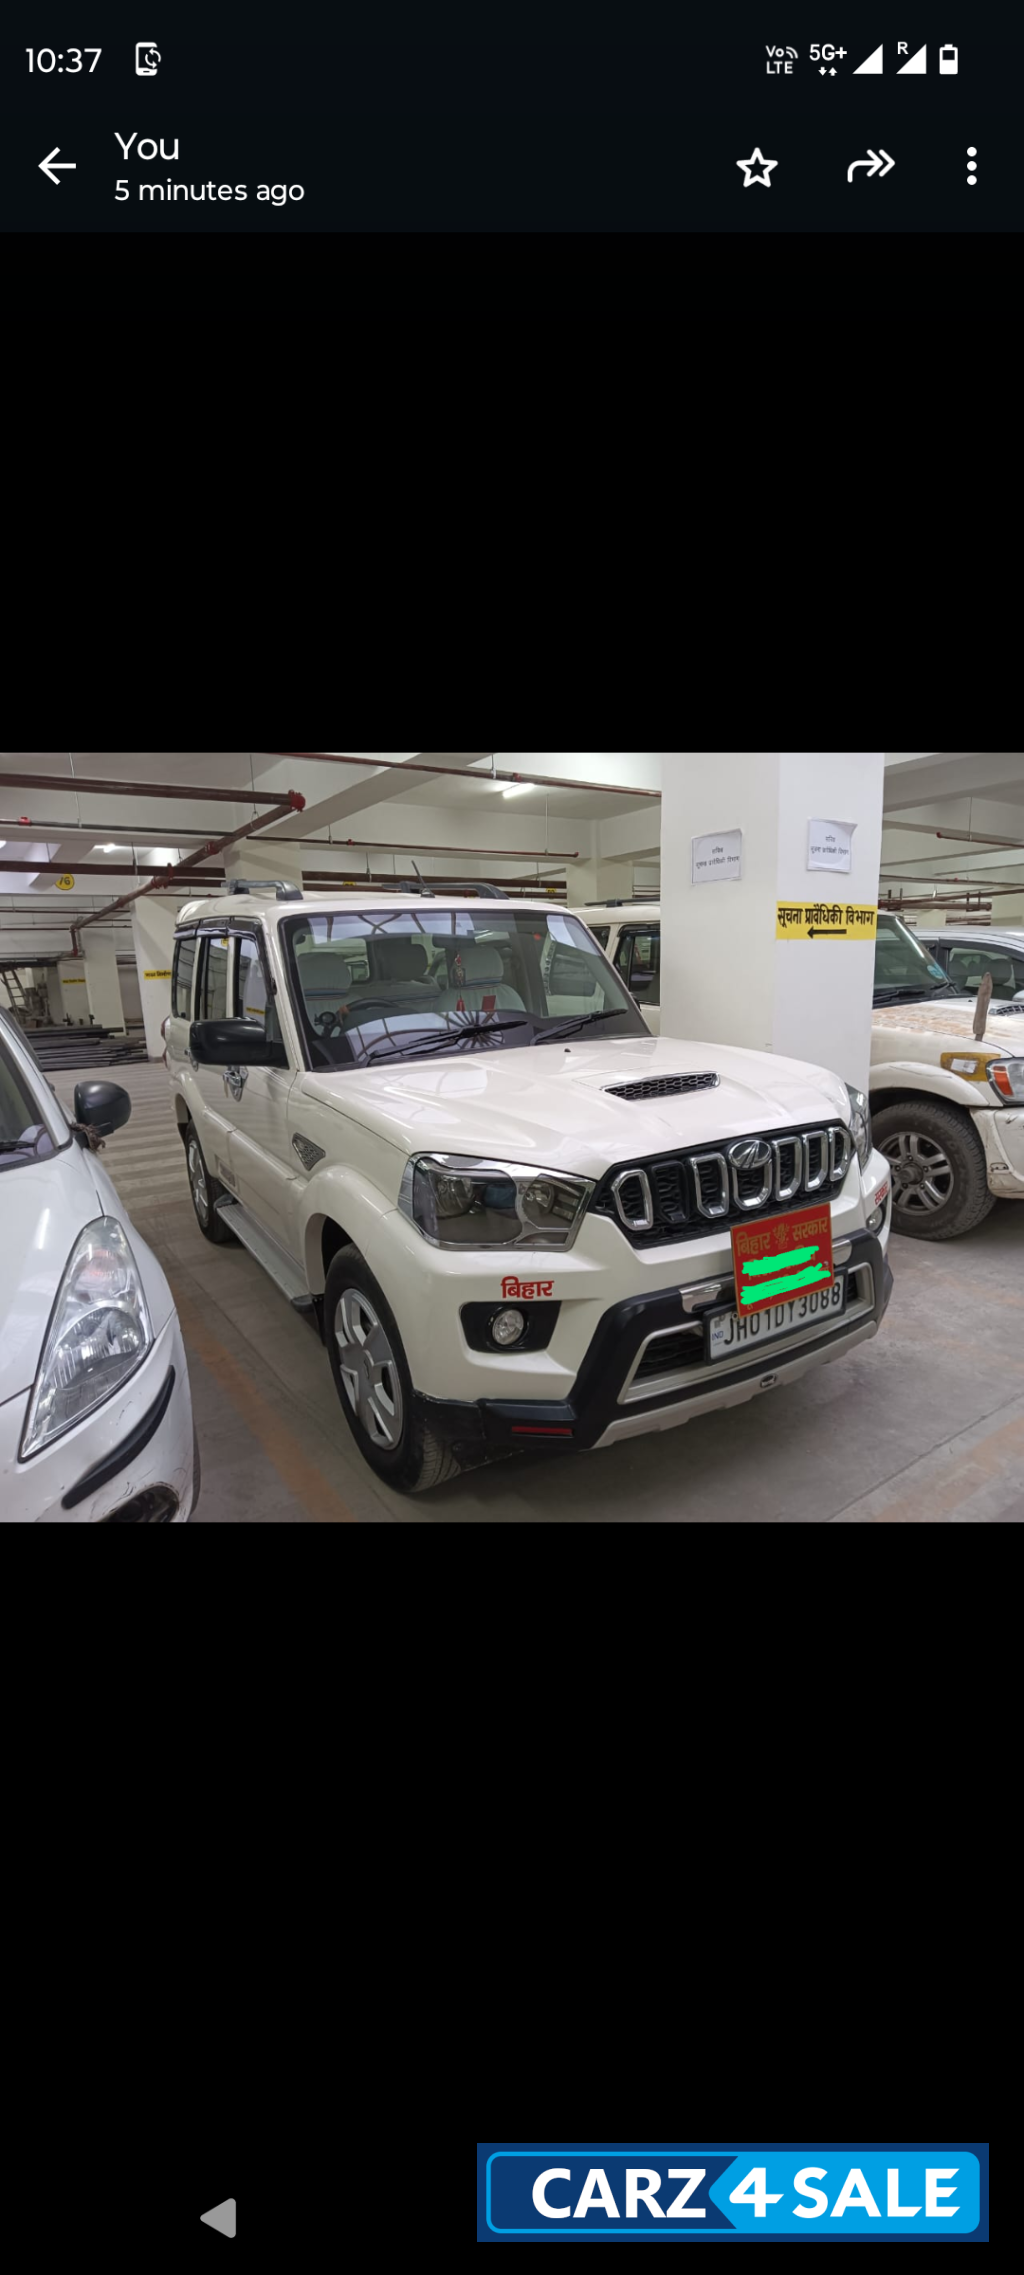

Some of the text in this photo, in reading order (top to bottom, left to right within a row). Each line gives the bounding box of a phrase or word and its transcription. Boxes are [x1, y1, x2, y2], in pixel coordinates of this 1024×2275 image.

[777, 903, 876, 928] सूचना प्रावैधिकी विभाग
[736, 1216, 828, 1257] बिहार सरकार
[500, 1275, 555, 1300] बिहार
